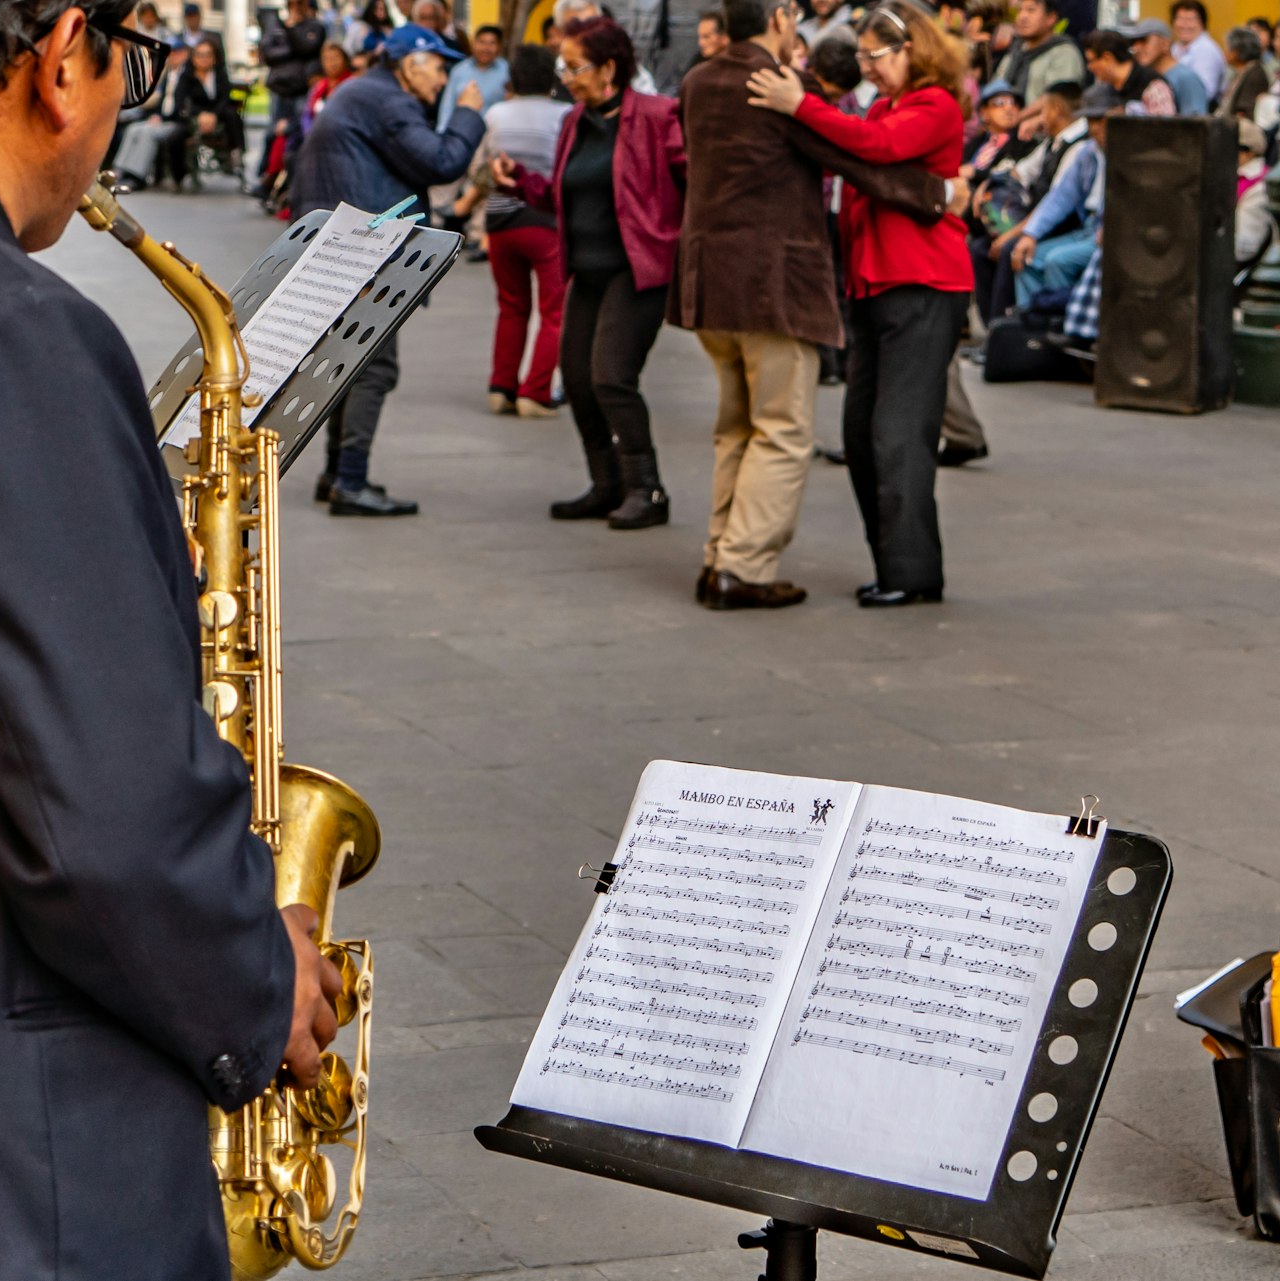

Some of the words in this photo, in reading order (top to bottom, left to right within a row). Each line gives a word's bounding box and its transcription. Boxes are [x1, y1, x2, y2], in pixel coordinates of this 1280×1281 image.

[679, 790, 724, 805] MAMBO
[728, 795, 745, 808] EN
[746, 798, 796, 814] ESPAÑA
